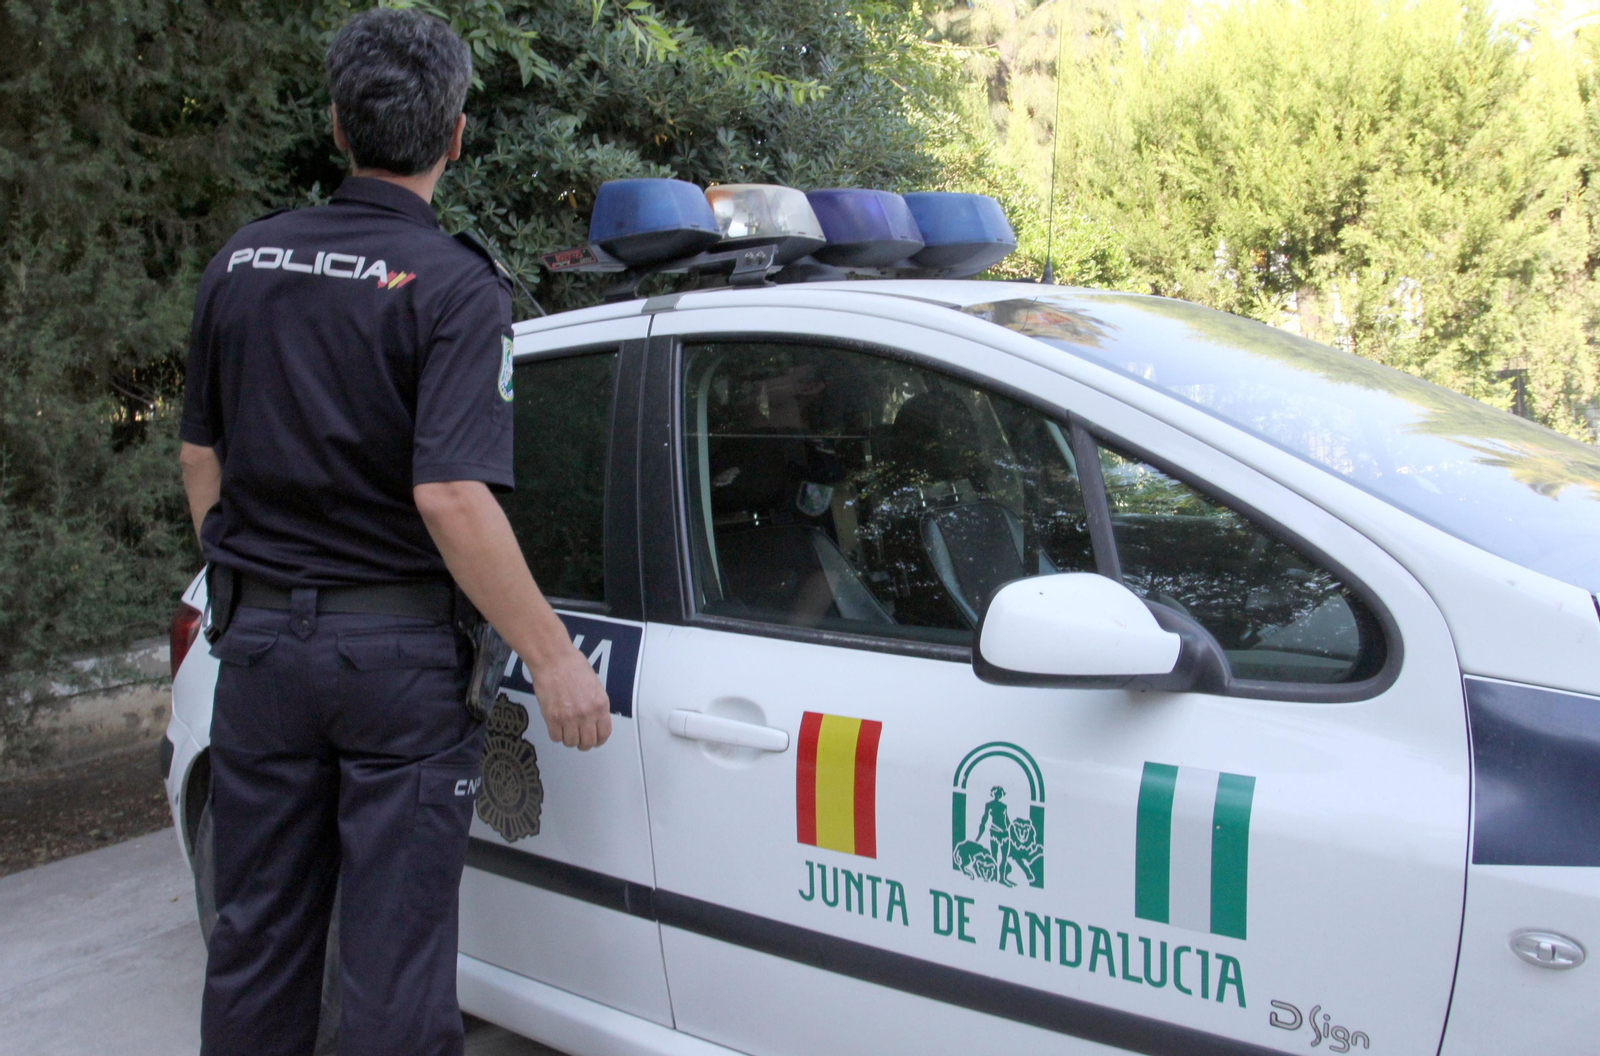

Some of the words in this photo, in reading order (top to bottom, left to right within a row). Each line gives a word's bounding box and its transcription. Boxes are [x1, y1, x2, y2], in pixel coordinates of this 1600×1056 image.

[227, 247, 388, 283] POLICIA
[798, 861, 909, 926] JUNTA
[929, 889, 976, 944] DE
[998, 904, 1247, 1009] ANDALUCIA
